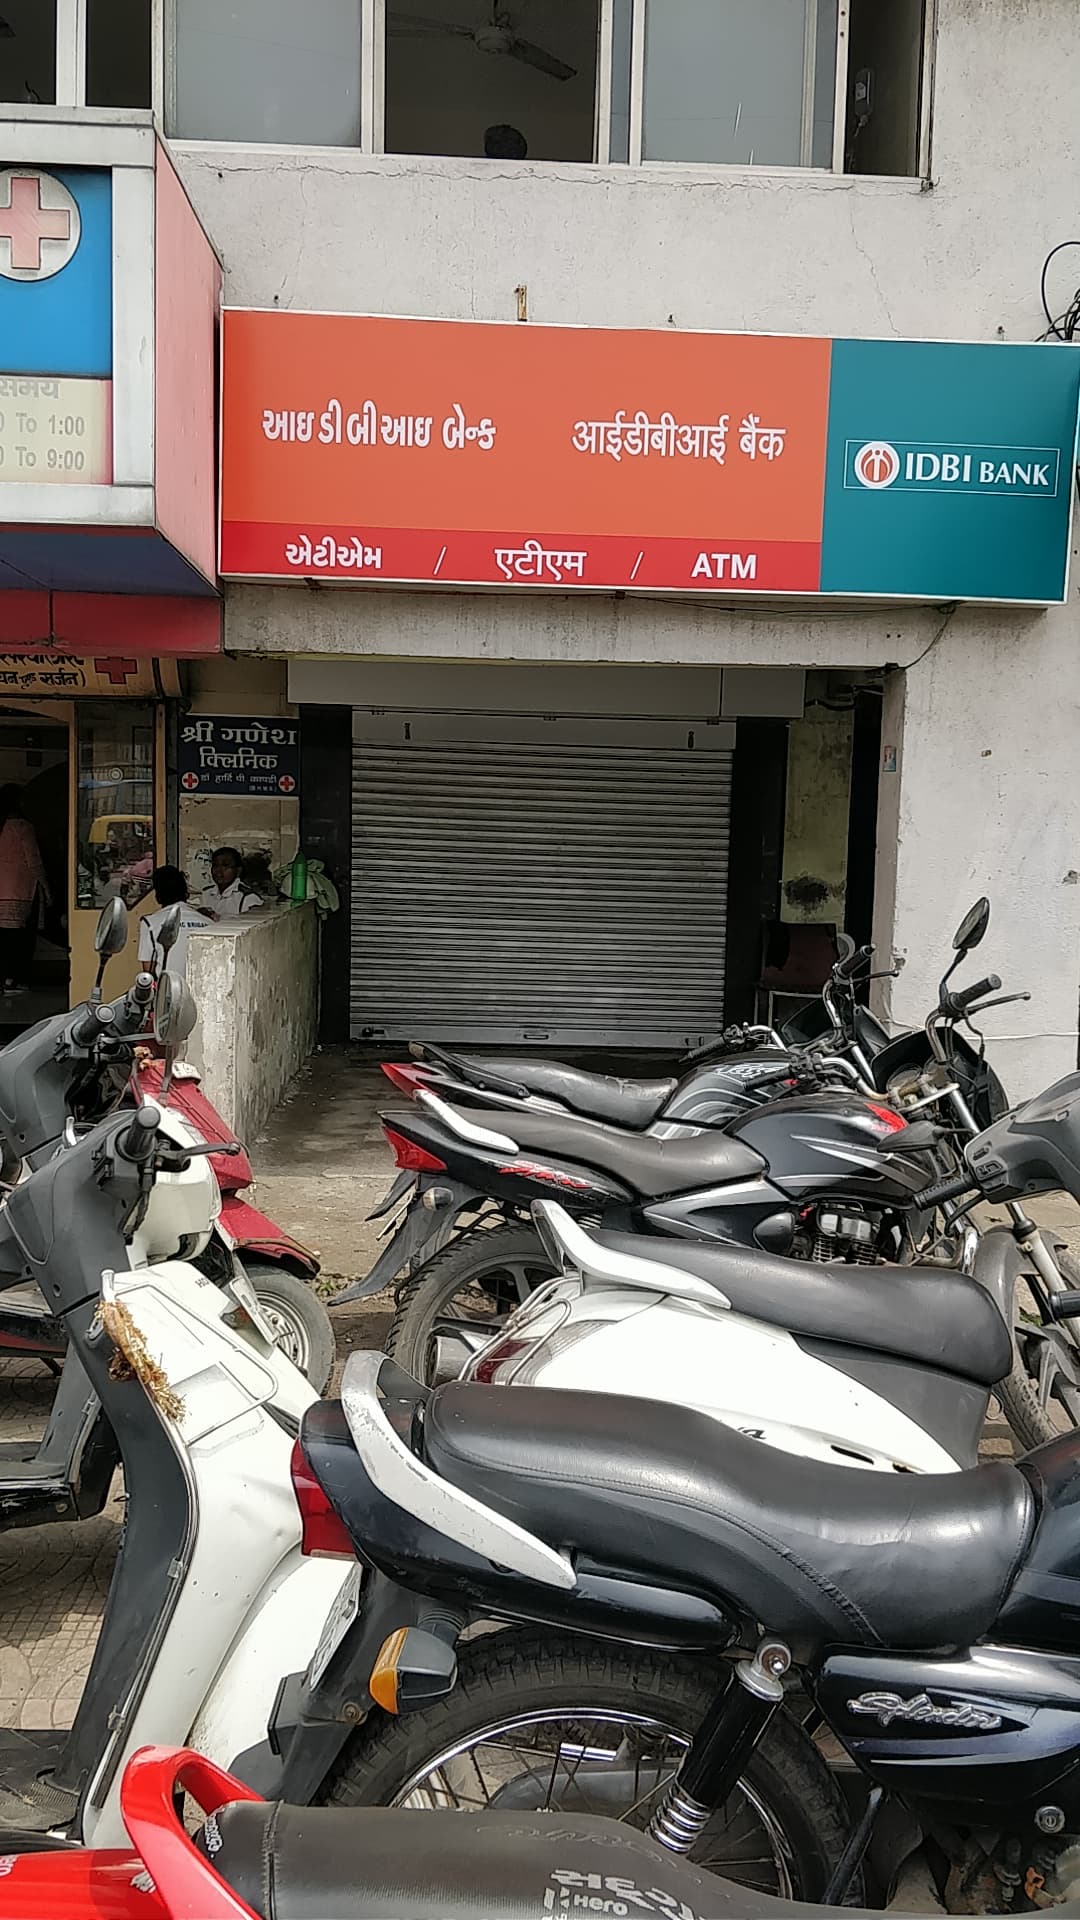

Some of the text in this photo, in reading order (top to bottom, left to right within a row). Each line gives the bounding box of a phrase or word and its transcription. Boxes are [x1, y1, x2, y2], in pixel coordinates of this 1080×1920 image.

[16, 412, 37, 433] To
[48, 414, 85, 437] 1:00
[443, 404, 496, 450] બેન્ક
[572, 410, 786, 465] आईडीबीआई बैंक
[15, 446, 37, 467] To
[47, 448, 85, 470] 9:00
[905, 452, 1049, 486] IDBI BANK
[285, 534, 382, 569] એટીએમ
[494, 539, 587, 581] एटीएम
[691, 553, 757, 579] ATM
[180, 720, 298, 745] श्री गणेश
[199, 745, 279, 769] क्लिनिक
[573, 1893, 629, 1917] Hero
